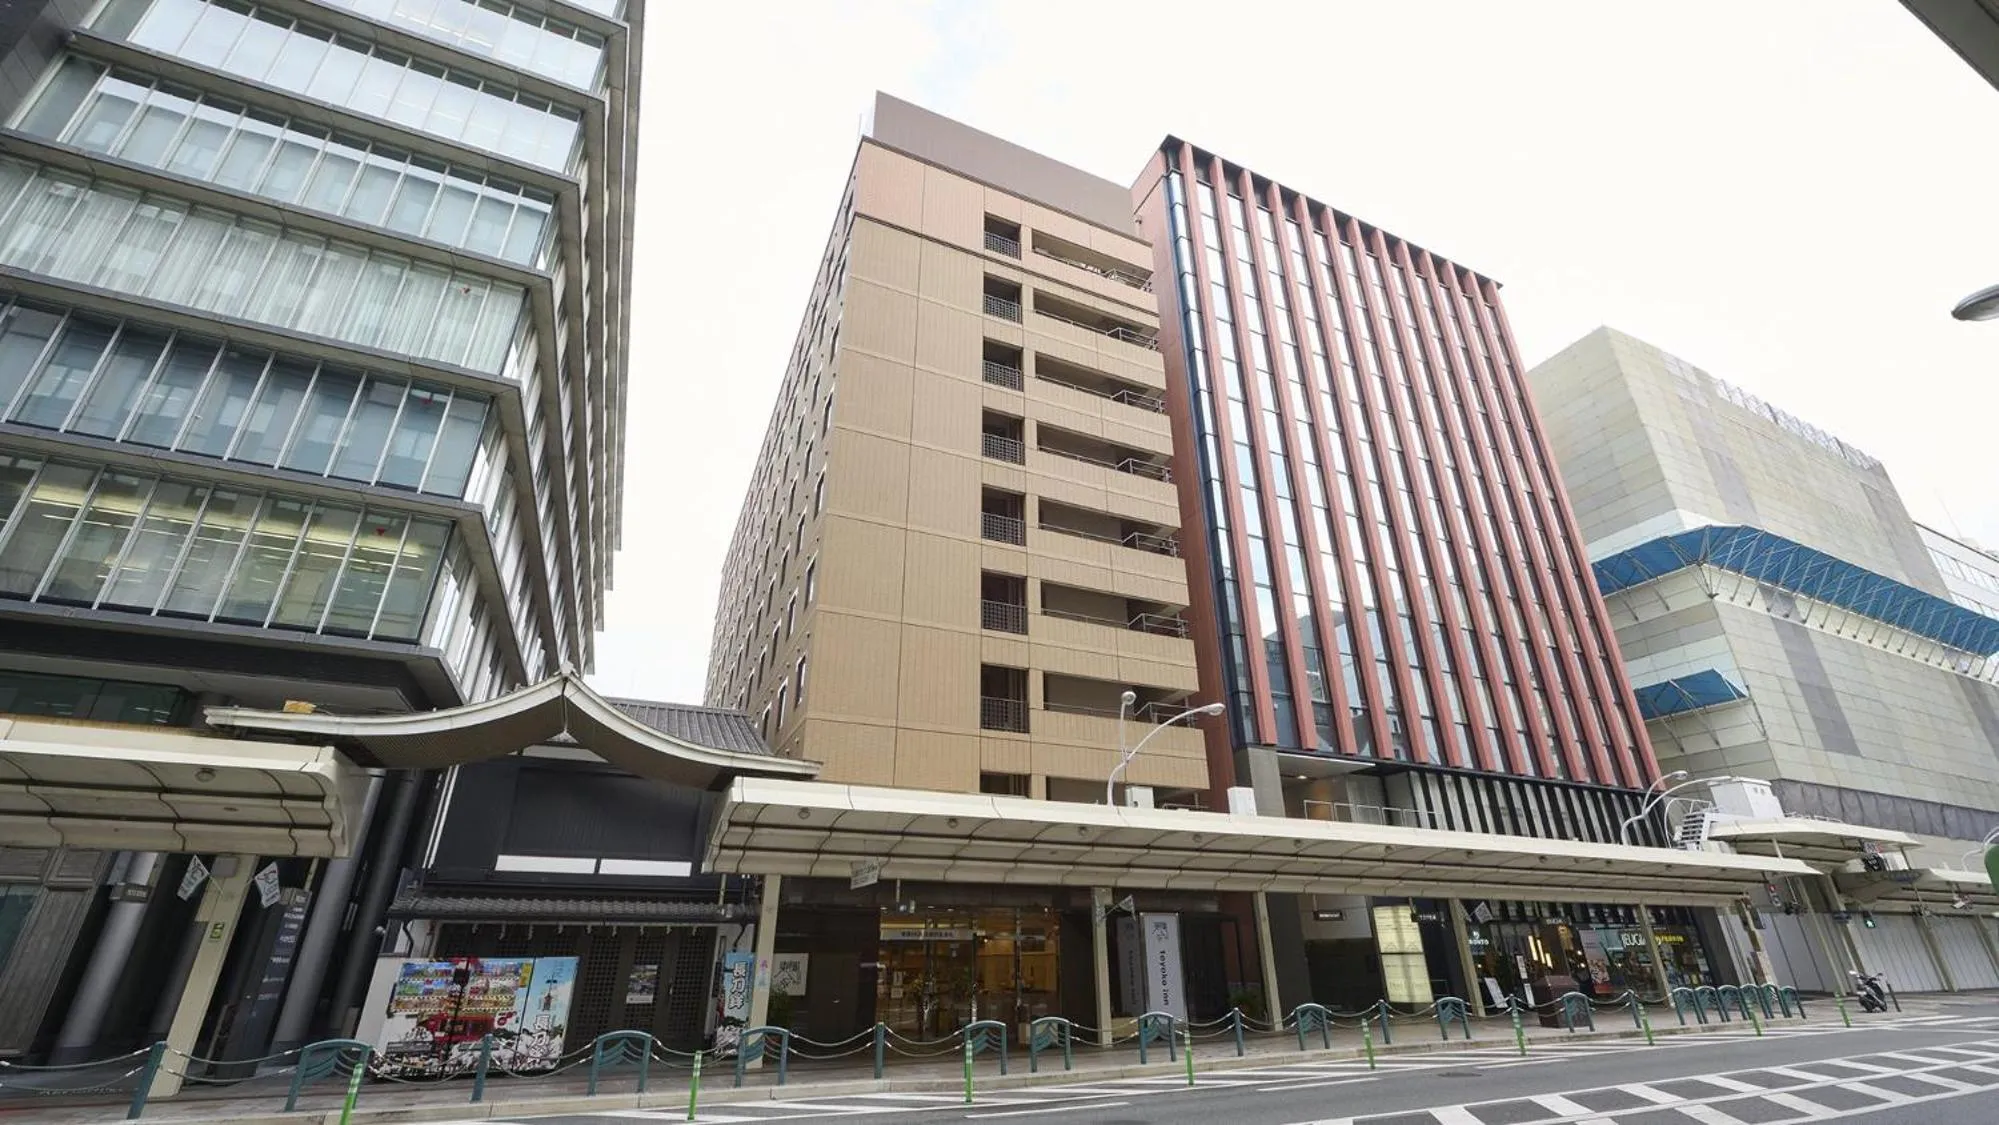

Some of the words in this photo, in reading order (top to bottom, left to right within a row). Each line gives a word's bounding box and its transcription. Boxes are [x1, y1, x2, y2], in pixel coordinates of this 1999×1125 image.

[728, 961, 747, 1010] 長刀鉾
[1159, 949, 1168, 986] toyoko
